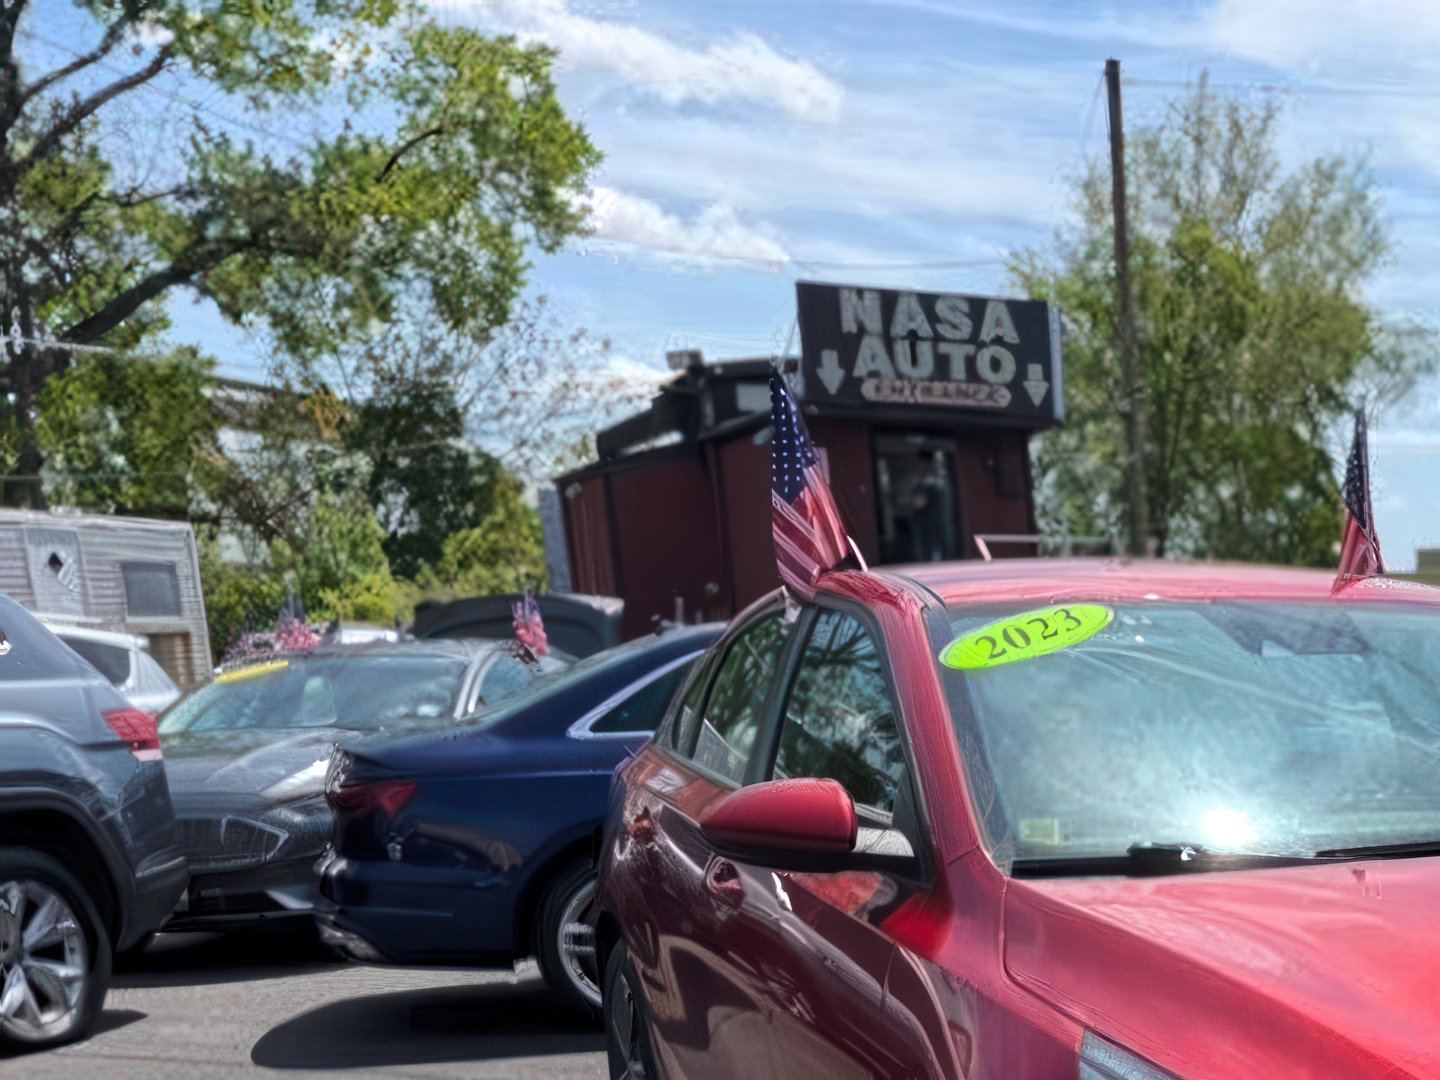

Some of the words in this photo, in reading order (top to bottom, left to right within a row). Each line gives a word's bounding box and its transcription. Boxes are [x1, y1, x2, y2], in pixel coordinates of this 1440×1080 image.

[839, 287, 1020, 344] NASA
[853, 334, 1017, 385] AUTO
[974, 608, 1082, 659] 2023
